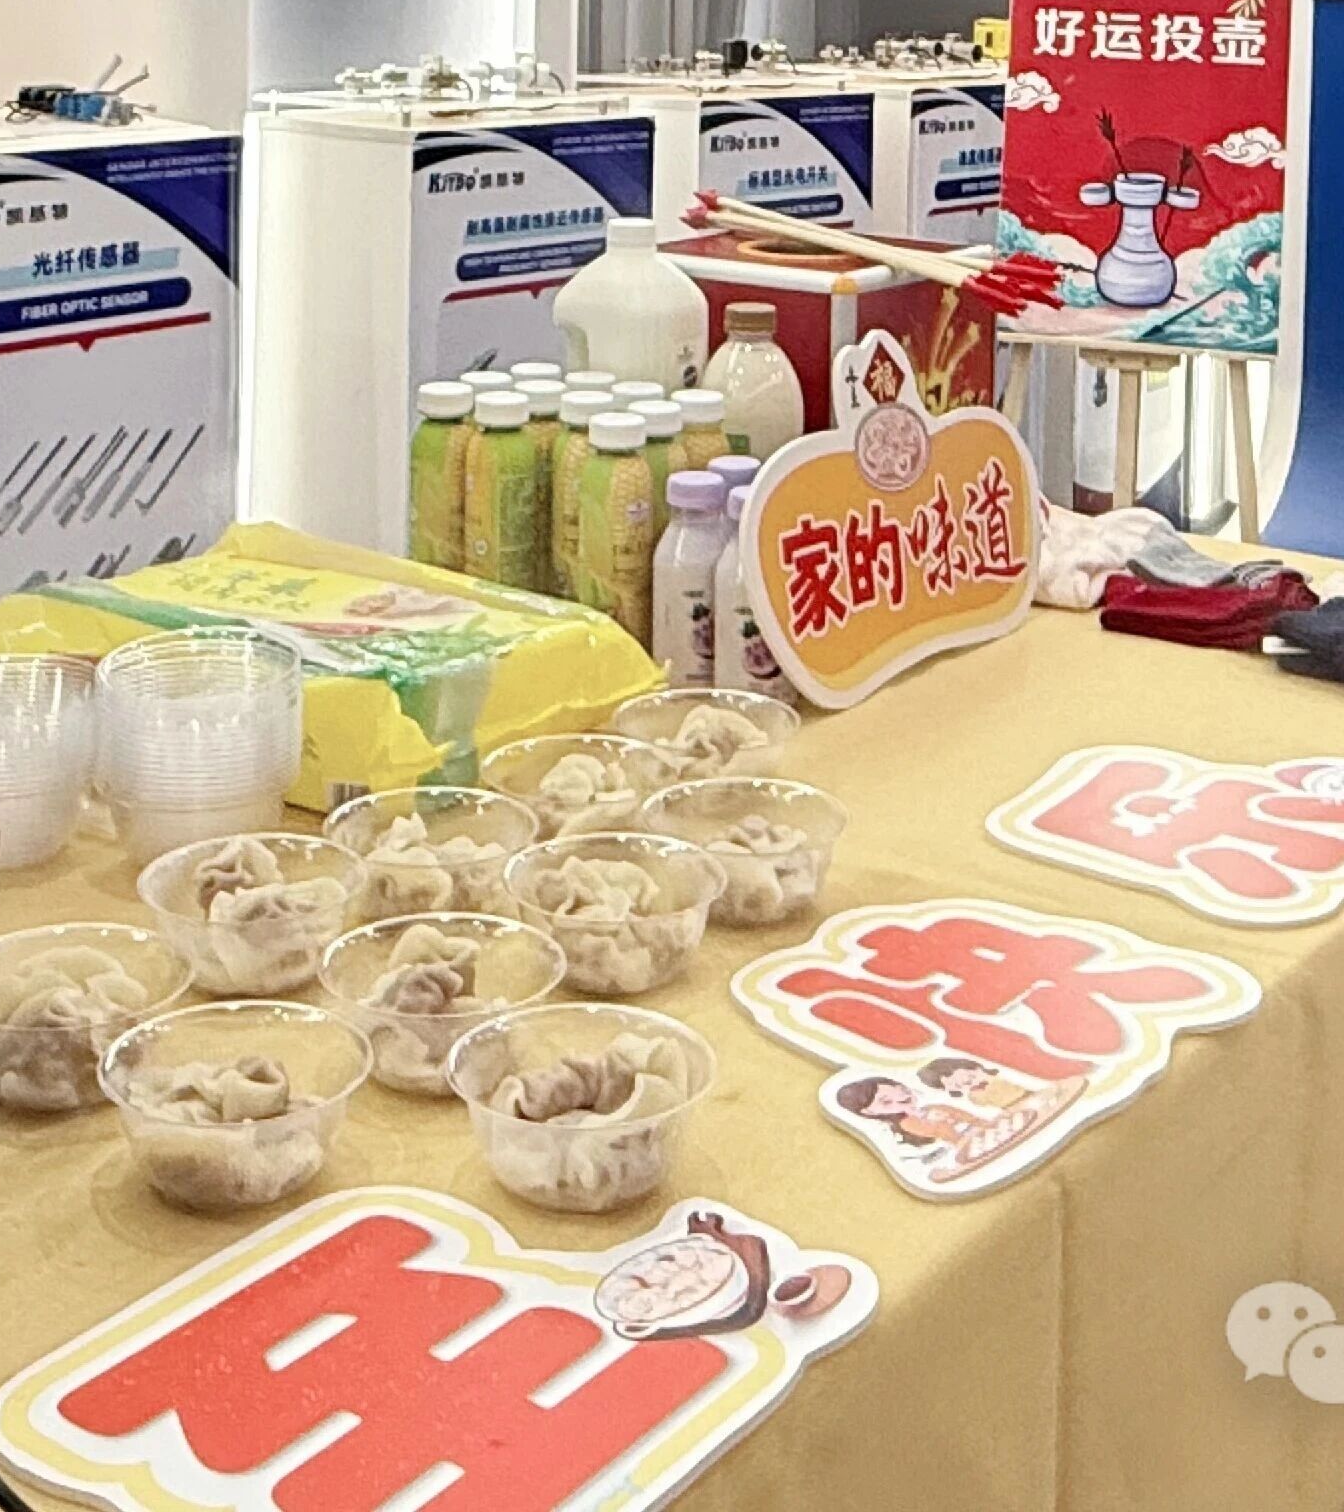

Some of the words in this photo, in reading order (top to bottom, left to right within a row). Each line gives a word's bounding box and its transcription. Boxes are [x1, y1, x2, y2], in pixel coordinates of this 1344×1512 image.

[1034, 7, 1267, 67] 好运投壶
[32, 241, 140, 279] 光纤传感器
[21, 302, 58, 321] FIBER
[60, 296, 98, 315] OPTIC
[100, 290, 149, 309] SENSOR
[778, 458, 1027, 642] 家的味道
